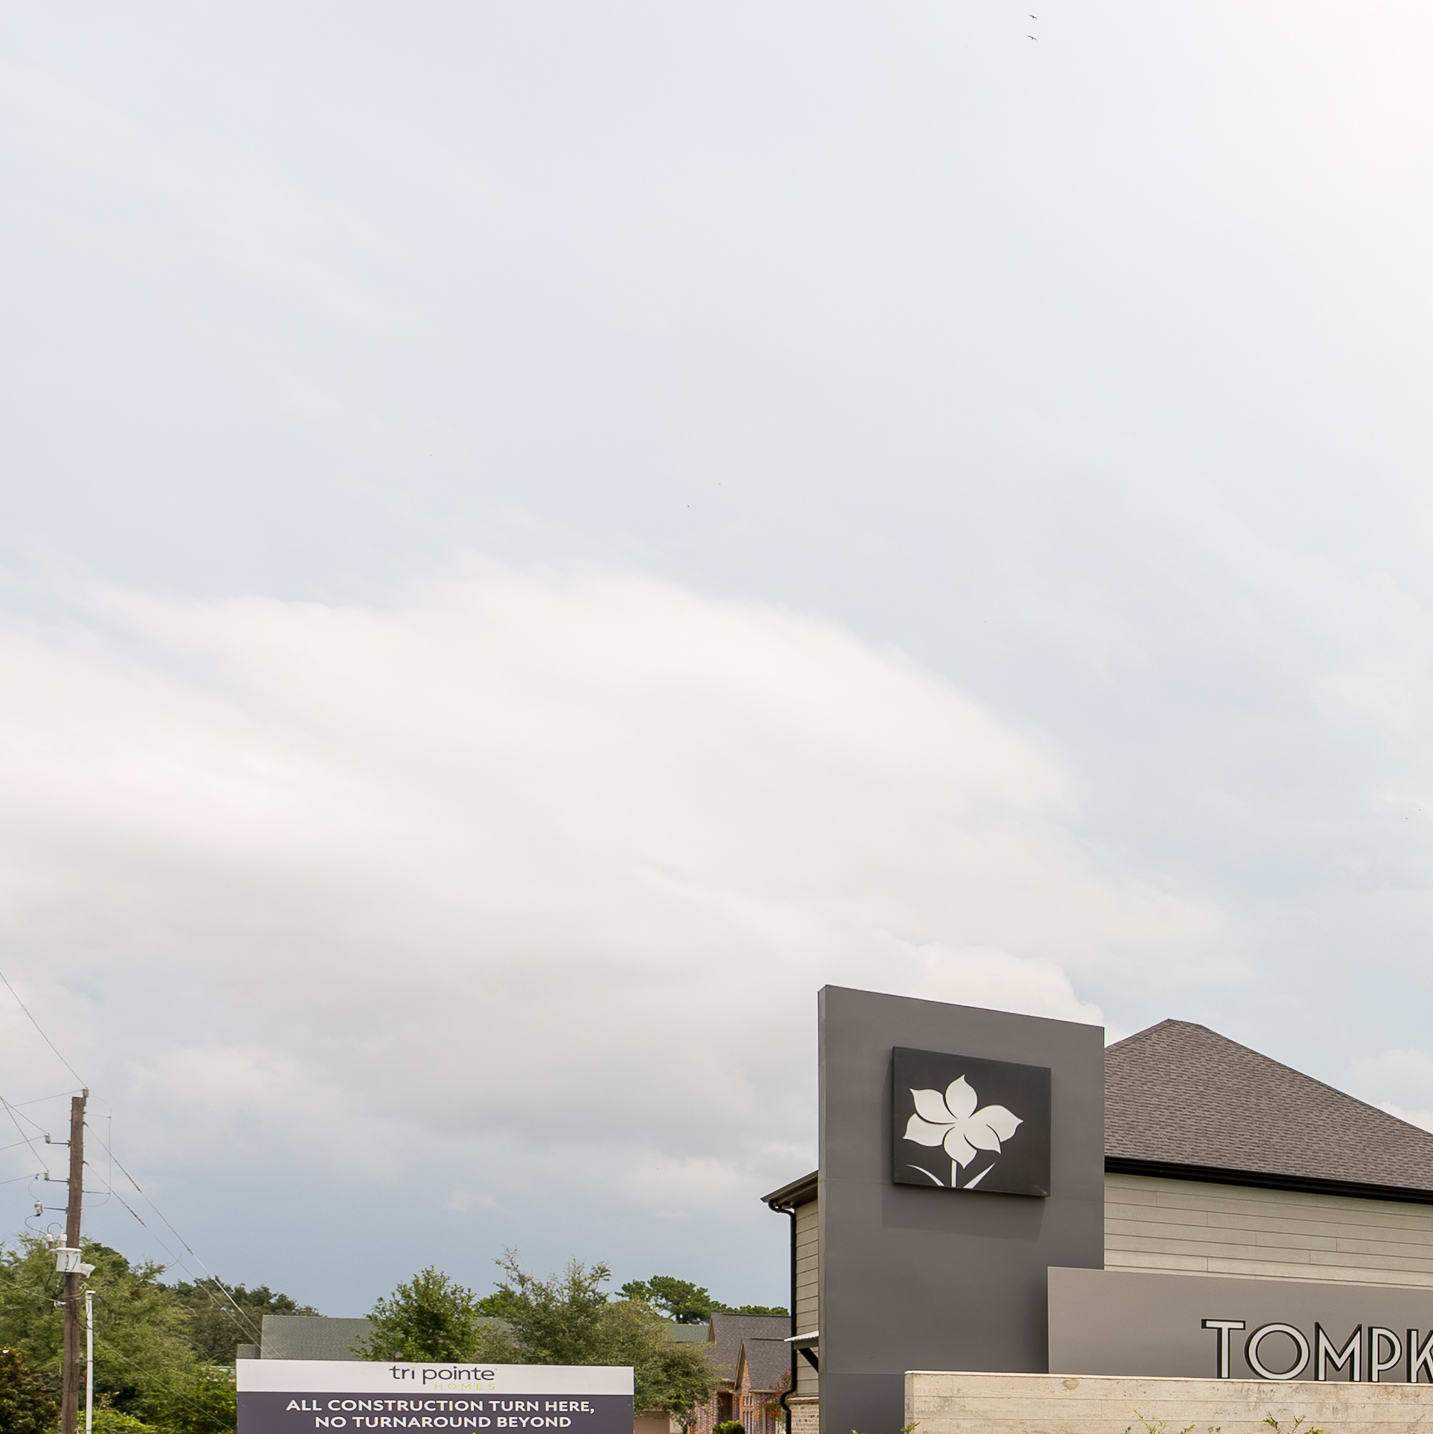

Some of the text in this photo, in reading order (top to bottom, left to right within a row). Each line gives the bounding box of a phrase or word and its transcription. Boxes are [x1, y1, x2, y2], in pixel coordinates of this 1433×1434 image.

[389, 1365, 495, 1384] tri pointe
[433, 1383, 496, 1391] HOMES
[286, 1399, 595, 1414] ALL CONSTRUCTION TURN HERE,
[315, 1416, 572, 1428] NO TURNAROUND BEYOND
